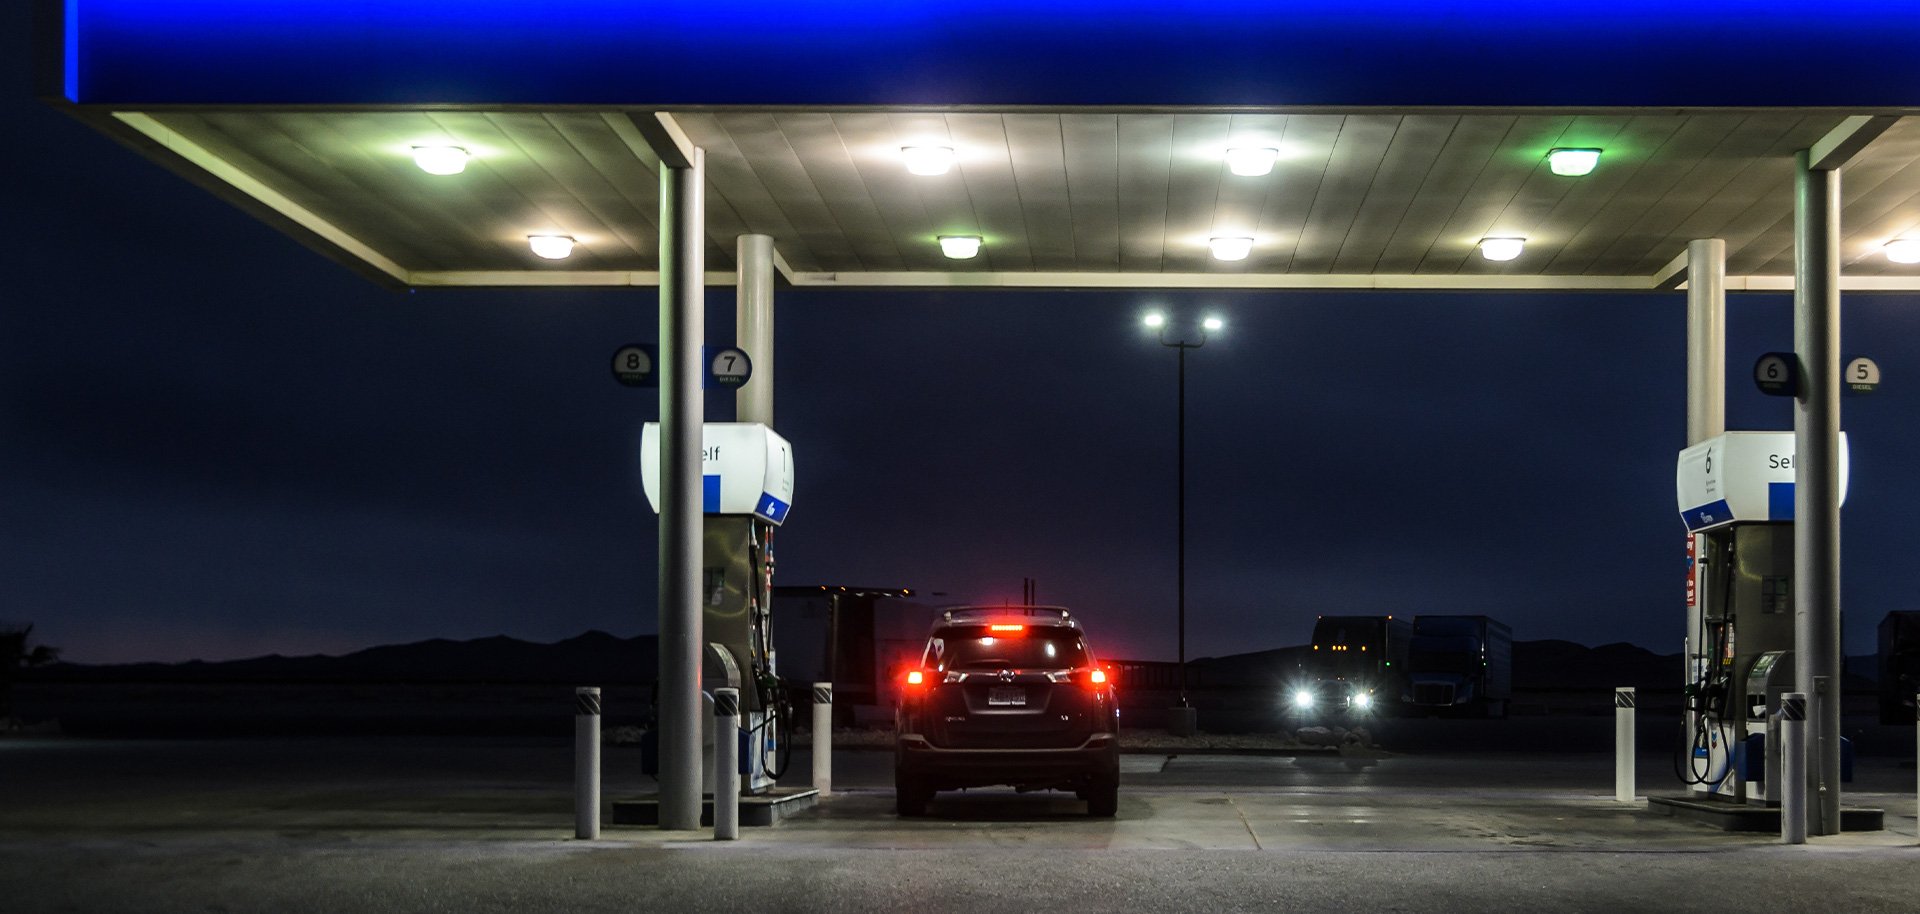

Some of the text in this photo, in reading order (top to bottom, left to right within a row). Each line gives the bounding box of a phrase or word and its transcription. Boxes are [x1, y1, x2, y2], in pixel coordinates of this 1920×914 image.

[626, 353, 640, 370] 8
[724, 356, 736, 372] 7
[1767, 363, 1778, 379] 6
[1857, 364, 1868, 380] 5
[703, 446, 720, 461] elf
[1705, 446, 1712, 474] 6
[1769, 454, 1795, 469] Sel
